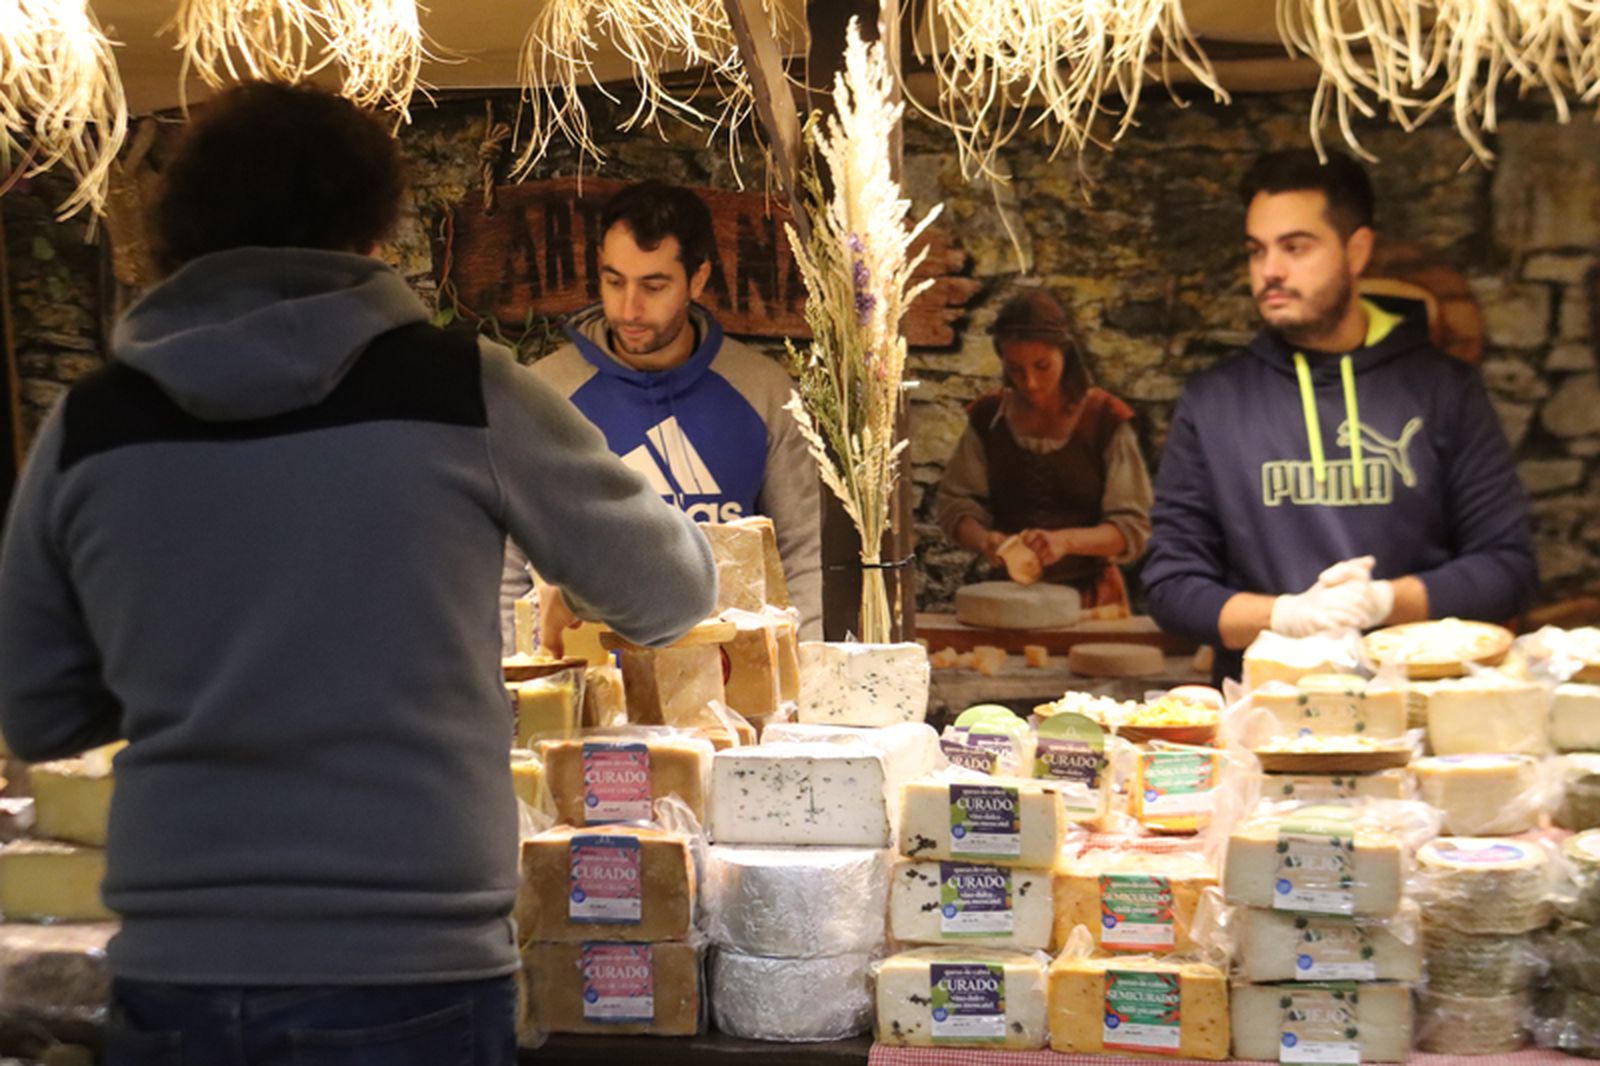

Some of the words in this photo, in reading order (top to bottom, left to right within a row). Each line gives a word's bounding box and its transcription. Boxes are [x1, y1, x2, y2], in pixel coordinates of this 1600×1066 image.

[1262, 457, 1392, 506] PUMA
[1041, 753, 1097, 768] CURADO
[585, 771, 648, 784] CURADO
[957, 798, 1013, 810] CURADO
[572, 866, 637, 880] CURADO
[948, 875, 1005, 888] CURADO
[585, 966, 649, 979] CURADO
[938, 978, 998, 992] CURADO
[1108, 991, 1178, 1003] SEMICURADO
